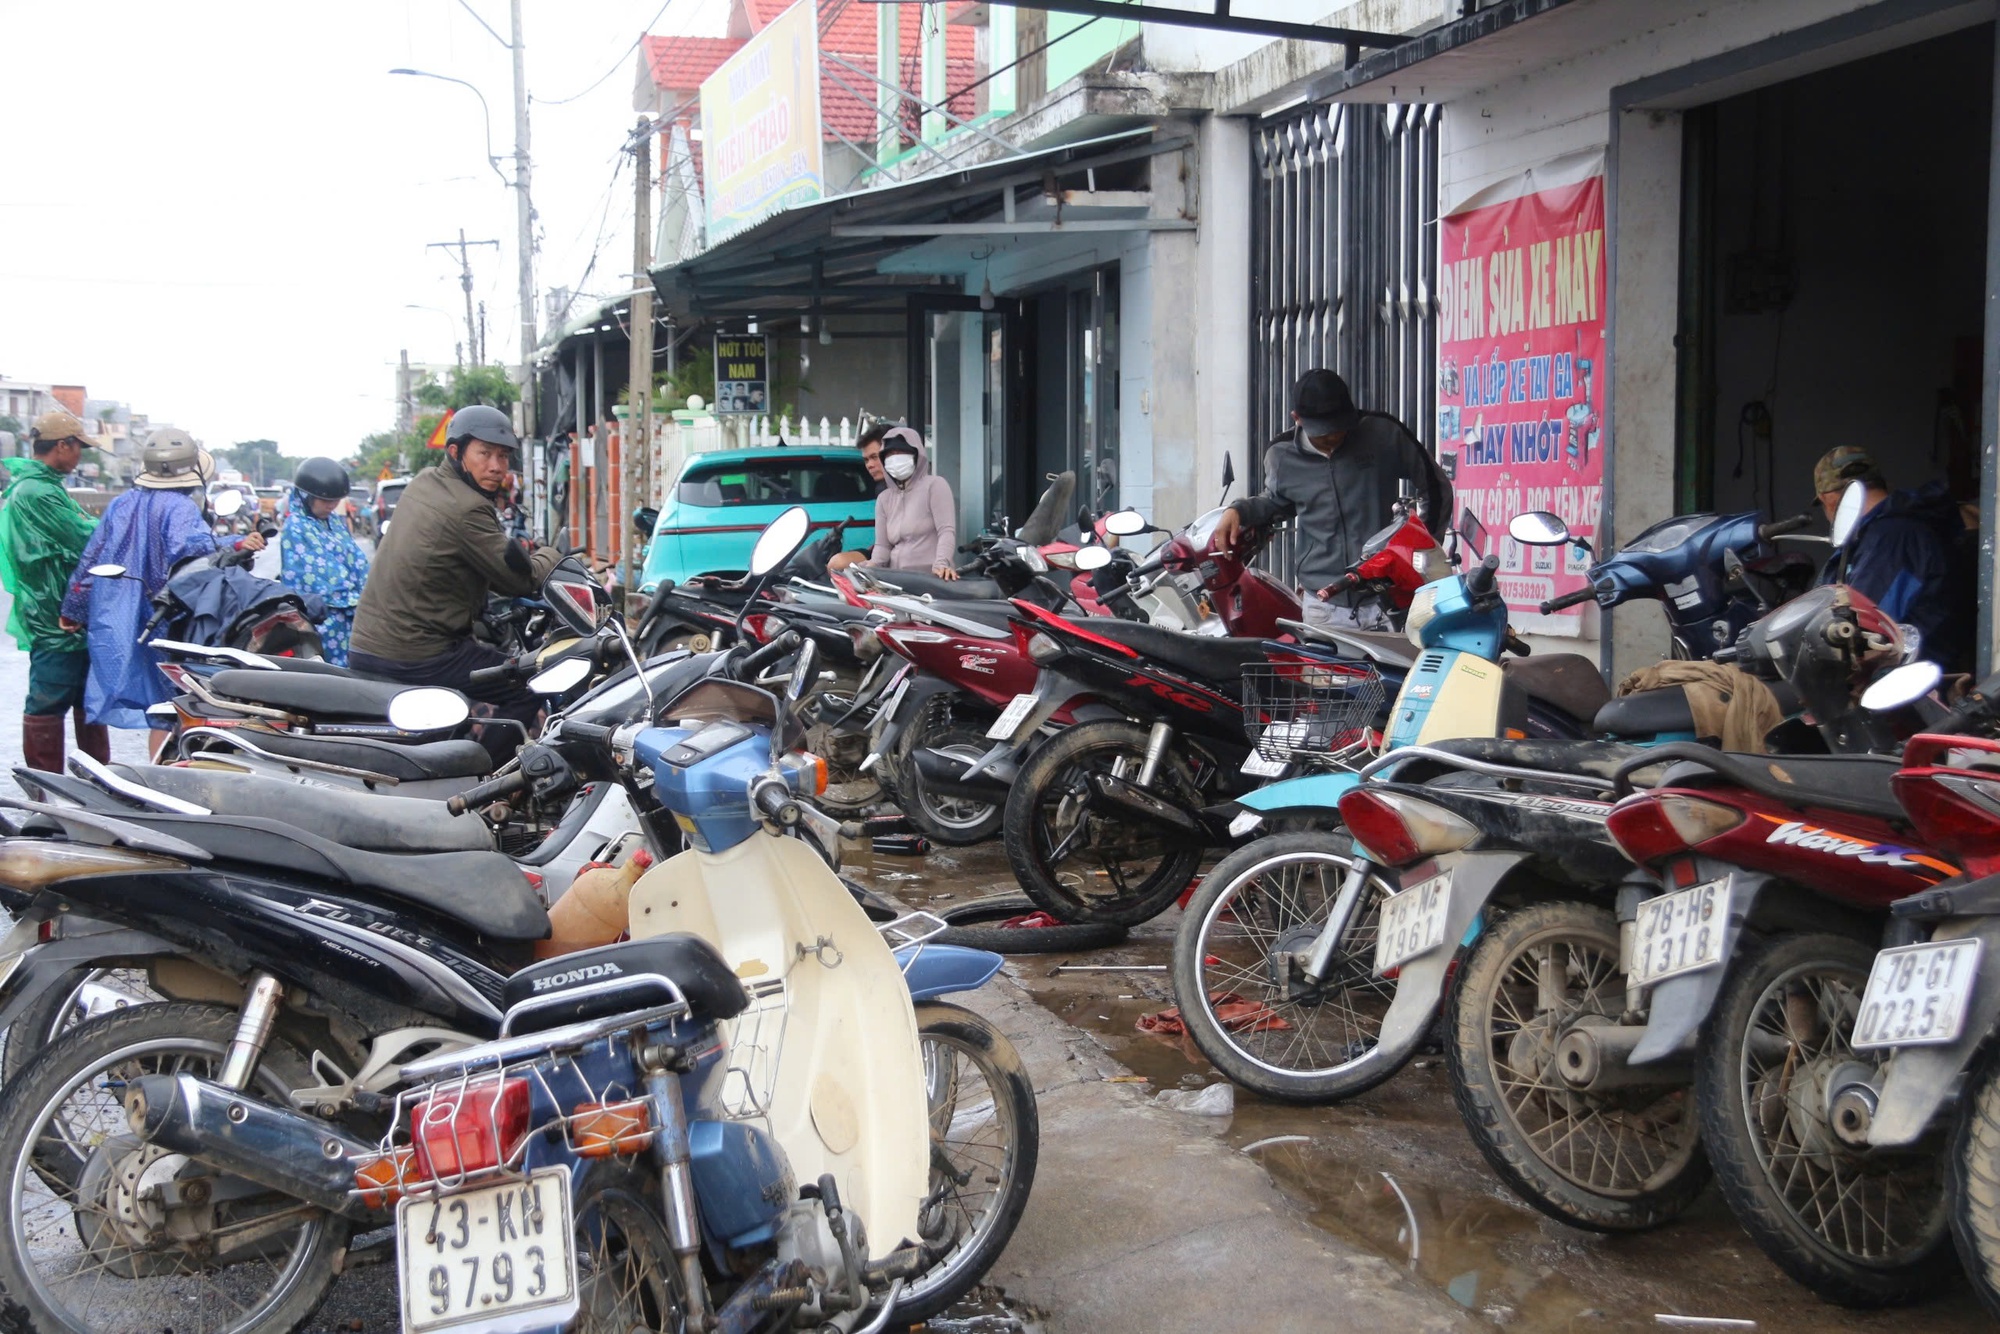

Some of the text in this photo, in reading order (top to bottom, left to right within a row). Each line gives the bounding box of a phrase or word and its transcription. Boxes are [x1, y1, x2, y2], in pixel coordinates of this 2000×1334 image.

[1488, 225, 1525, 338] SỬA
[1528, 240, 1550, 330] XE
[1554, 213, 1602, 326] MÁY
[728, 363, 756, 378] NAM
[1463, 346, 1573, 408] VÁ LỐP XE TAY GA
[1463, 423, 1507, 467] THAY
[1455, 489, 1485, 525] THAY
[1554, 477, 1579, 526] YÊN
[1535, 562, 1552, 570] SUZUKI
[1765, 821, 1874, 856] Wave
[1645, 886, 1715, 938] 78-H6
[1383, 914, 1434, 967] 7961
[1643, 926, 1711, 978] 1318
[532, 962, 624, 991] HONDA
[1884, 947, 1960, 995] 78-G1
[425, 1183, 544, 1254] 43-KN
